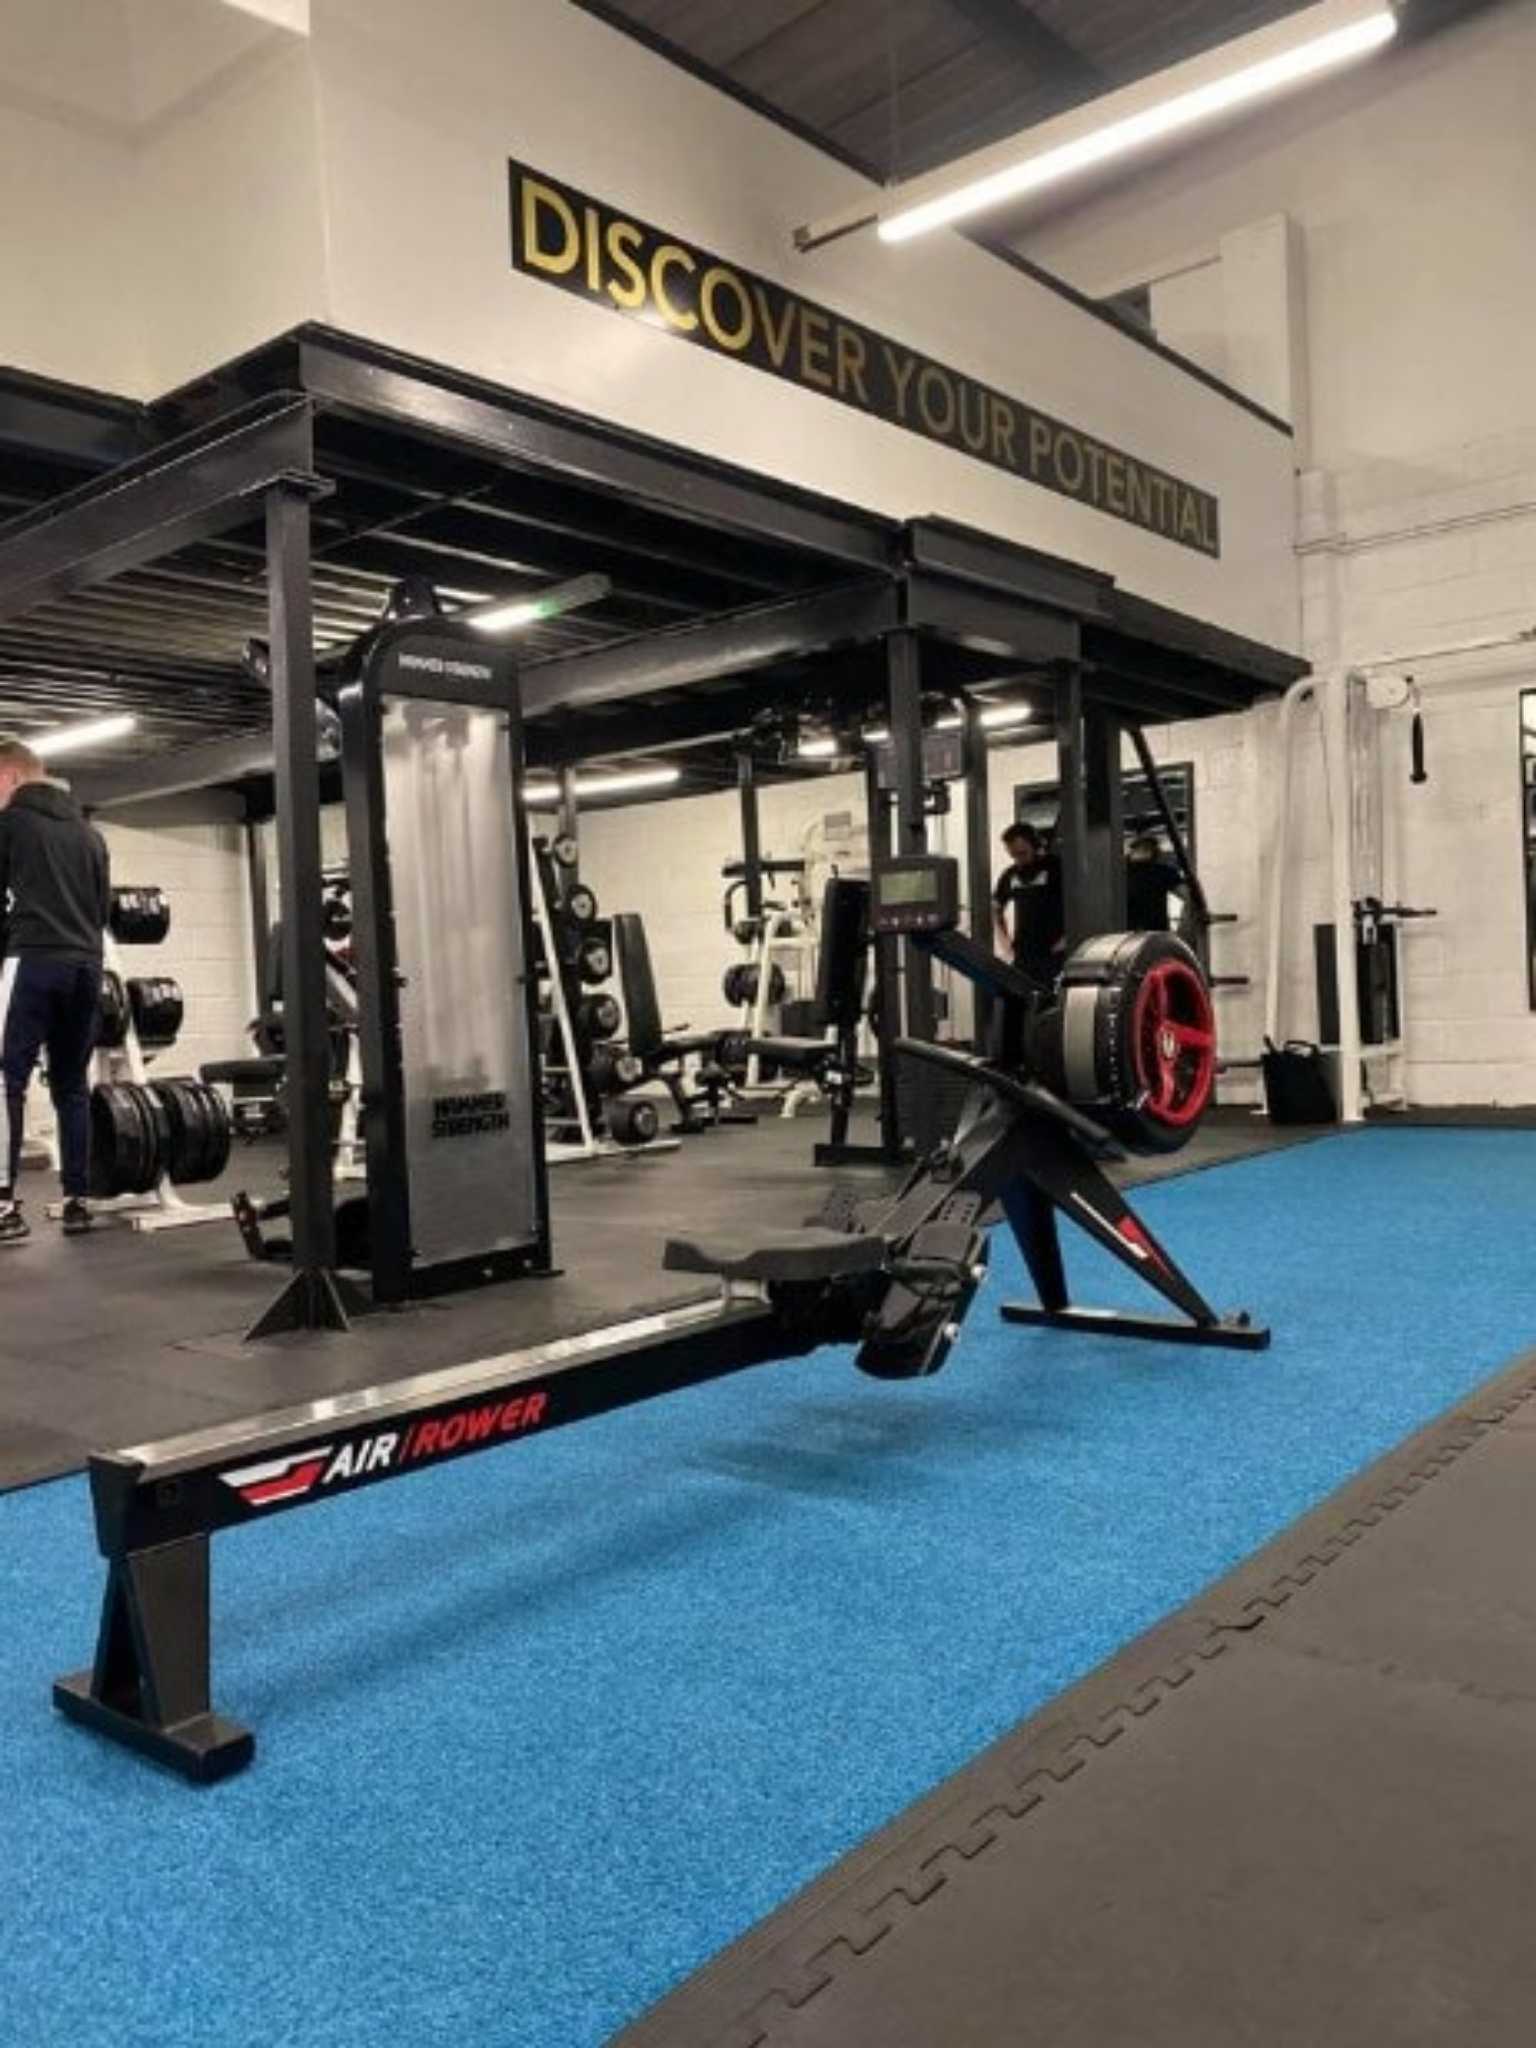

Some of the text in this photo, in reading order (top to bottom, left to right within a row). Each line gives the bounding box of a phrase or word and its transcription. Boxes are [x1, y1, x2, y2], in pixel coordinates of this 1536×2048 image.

[520, 177, 1219, 549] DISCOVER YOUR POTENTIAL
